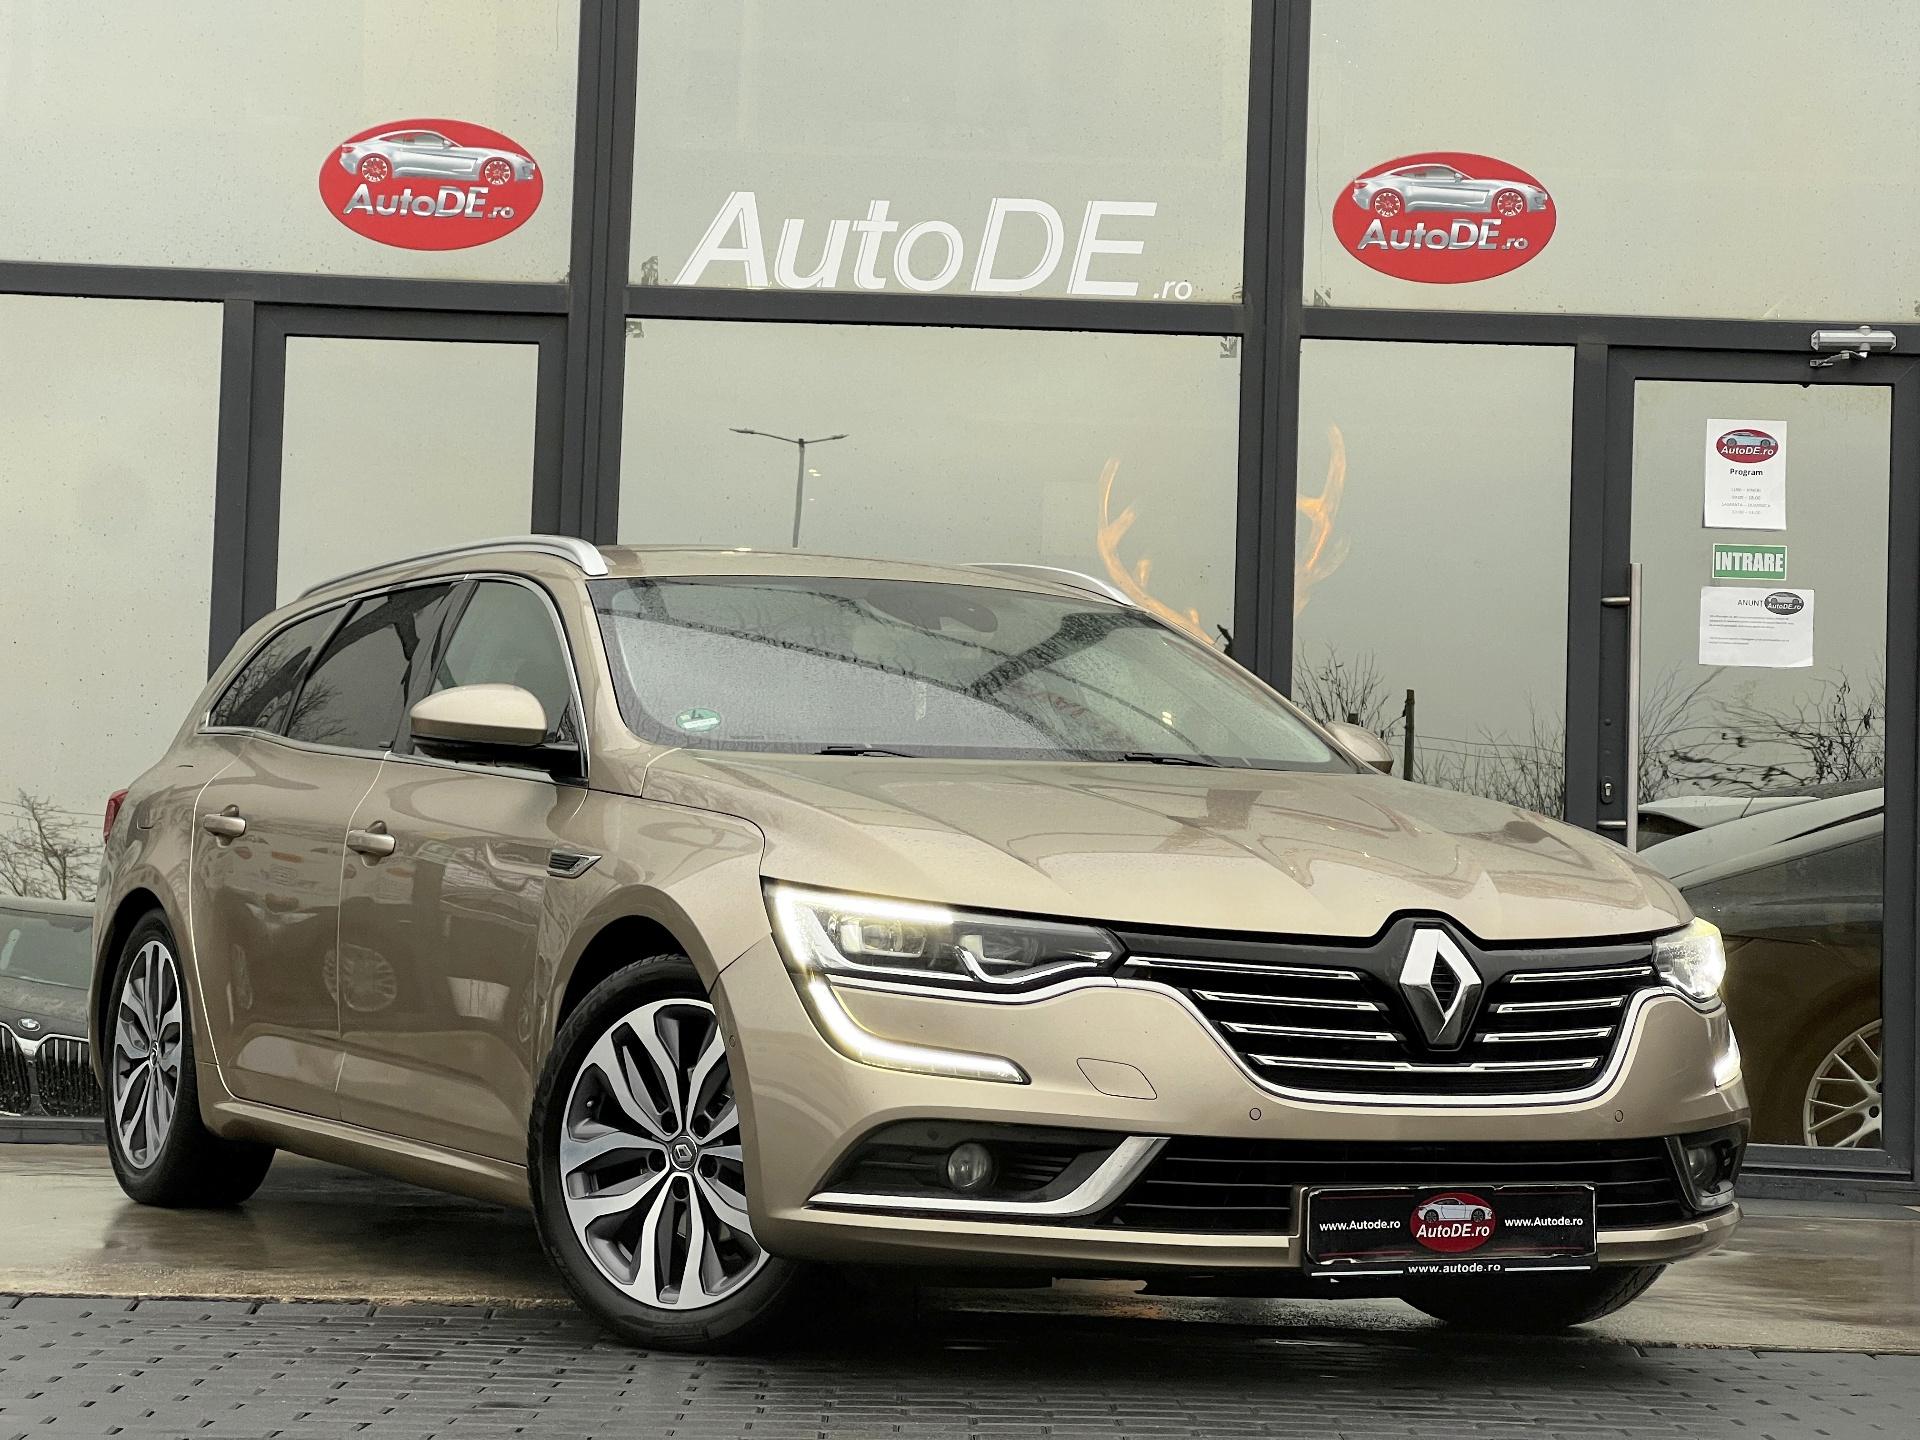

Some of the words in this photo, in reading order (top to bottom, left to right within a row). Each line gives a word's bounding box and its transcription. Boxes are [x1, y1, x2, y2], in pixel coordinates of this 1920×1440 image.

[1720, 446, 1774, 456] AutoDE.ro
[1729, 468, 1763, 477] Program
[1715, 551, 1785, 572] INTRARE
[1319, 1219, 1401, 1231] www.Autode.ro
[1504, 1216, 1584, 1227] www.Autode.ro
[1416, 1223, 1490, 1239] AutoDE.ro
[1408, 1262, 1501, 1274] www.autode.ro
